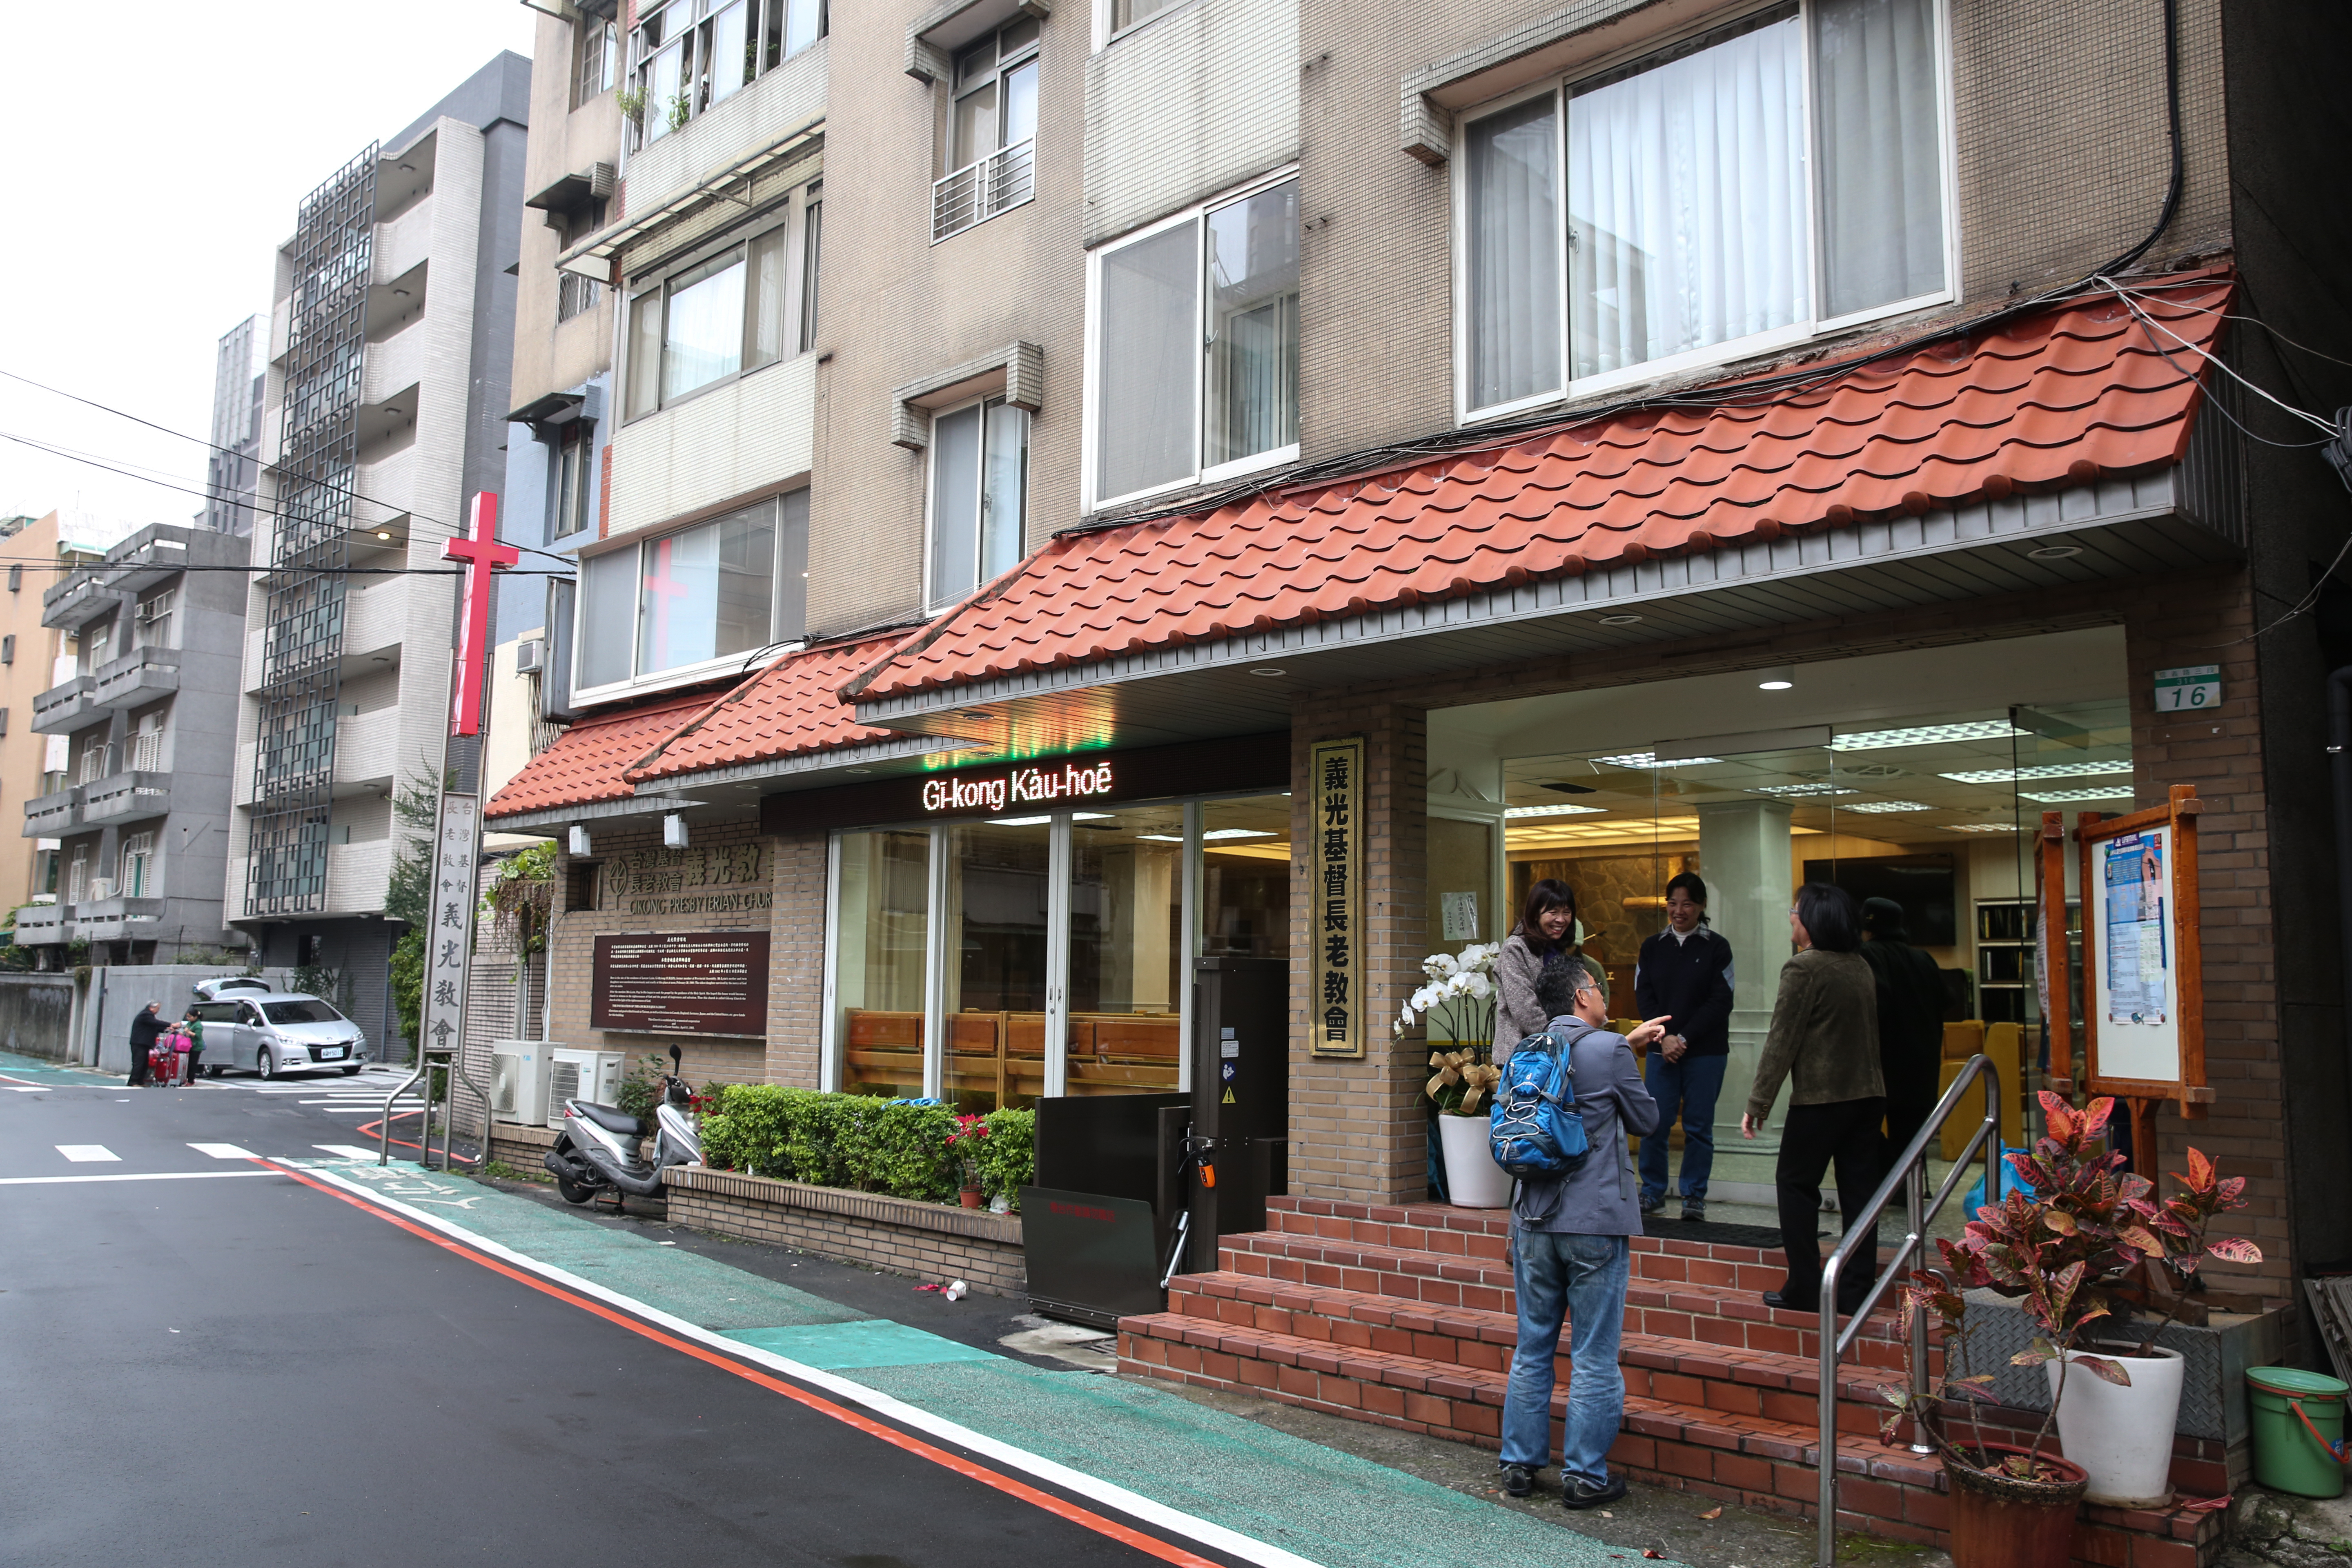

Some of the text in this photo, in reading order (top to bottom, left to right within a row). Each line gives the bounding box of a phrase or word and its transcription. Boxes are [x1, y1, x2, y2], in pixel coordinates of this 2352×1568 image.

[2172, 686, 2206, 708] 16
[923, 777, 1006, 811] Gi-kong
[440, 801, 459, 893] 長老教會
[456, 802, 473, 893] 台灣基督
[630, 848, 683, 870] 台灣基督
[630, 872, 682, 893] 長老教會
[1324, 757, 1349, 1042] 義光基督長老教會
[629, 899, 666, 915] GIKONG
[669, 893, 738, 913] PRESBYTERIAN
[430, 902, 463, 1047] 義光教會
